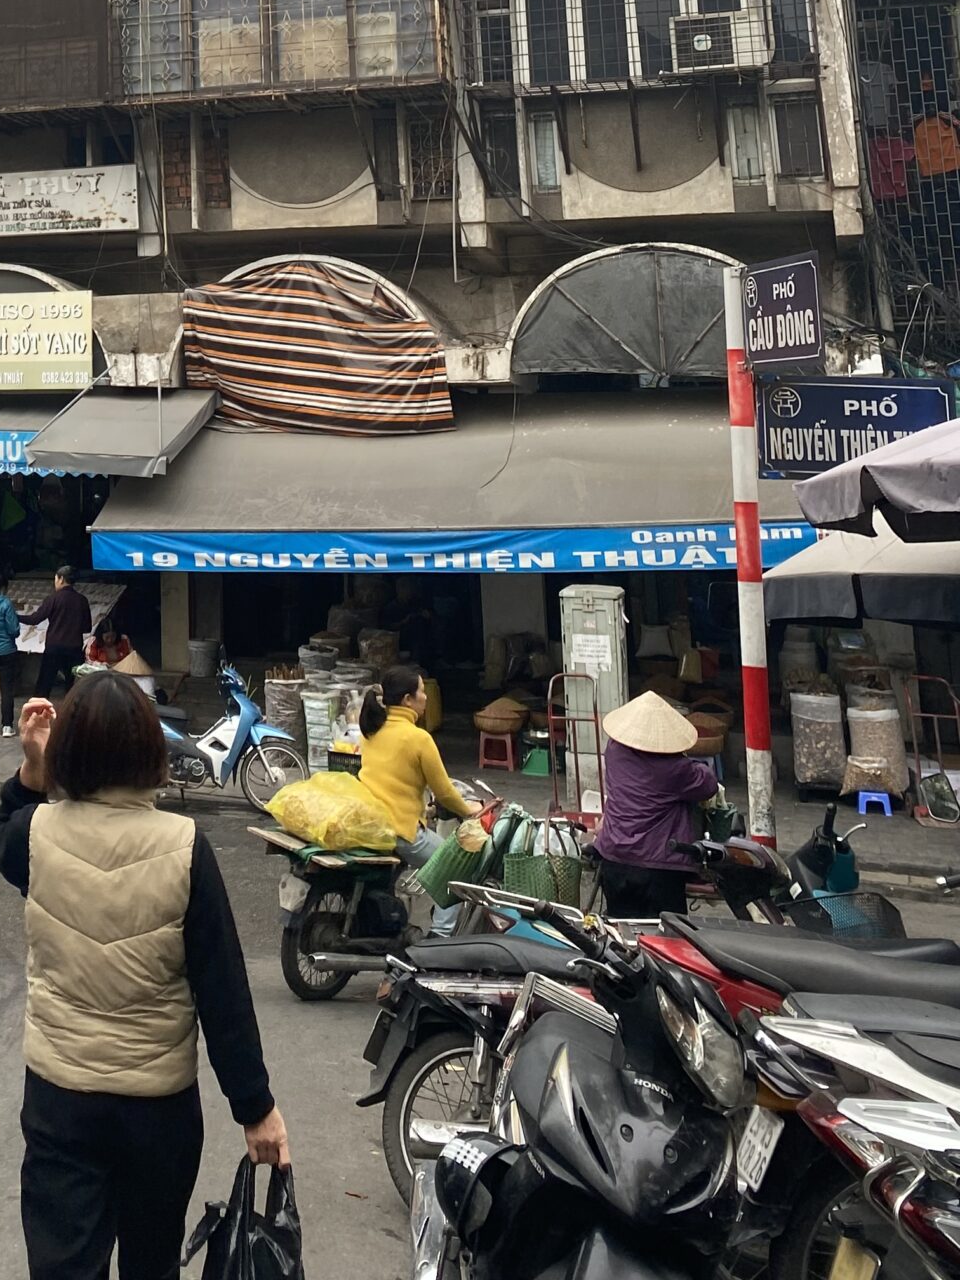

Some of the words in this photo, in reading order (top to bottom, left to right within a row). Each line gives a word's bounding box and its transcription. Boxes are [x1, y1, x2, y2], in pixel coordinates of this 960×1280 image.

[772, 273, 796, 301] PHỐ
[40, 304, 84, 319] 1996
[11, 323, 41, 356] SỐT
[44, 332, 88, 355] VANG
[748, 305, 774, 352] CẦU
[776, 306, 816, 349] ĐÔNG
[843, 393, 899, 417] PHỐ
[769, 419, 838, 462] NGUYỄN
[631, 527, 717, 544] Oanh
[125, 551, 180, 568] 19
[194, 547, 389, 569] NGUYỄN
[404, 549, 556, 573] THIỆN
[633, 1078, 674, 1103] HONDA
